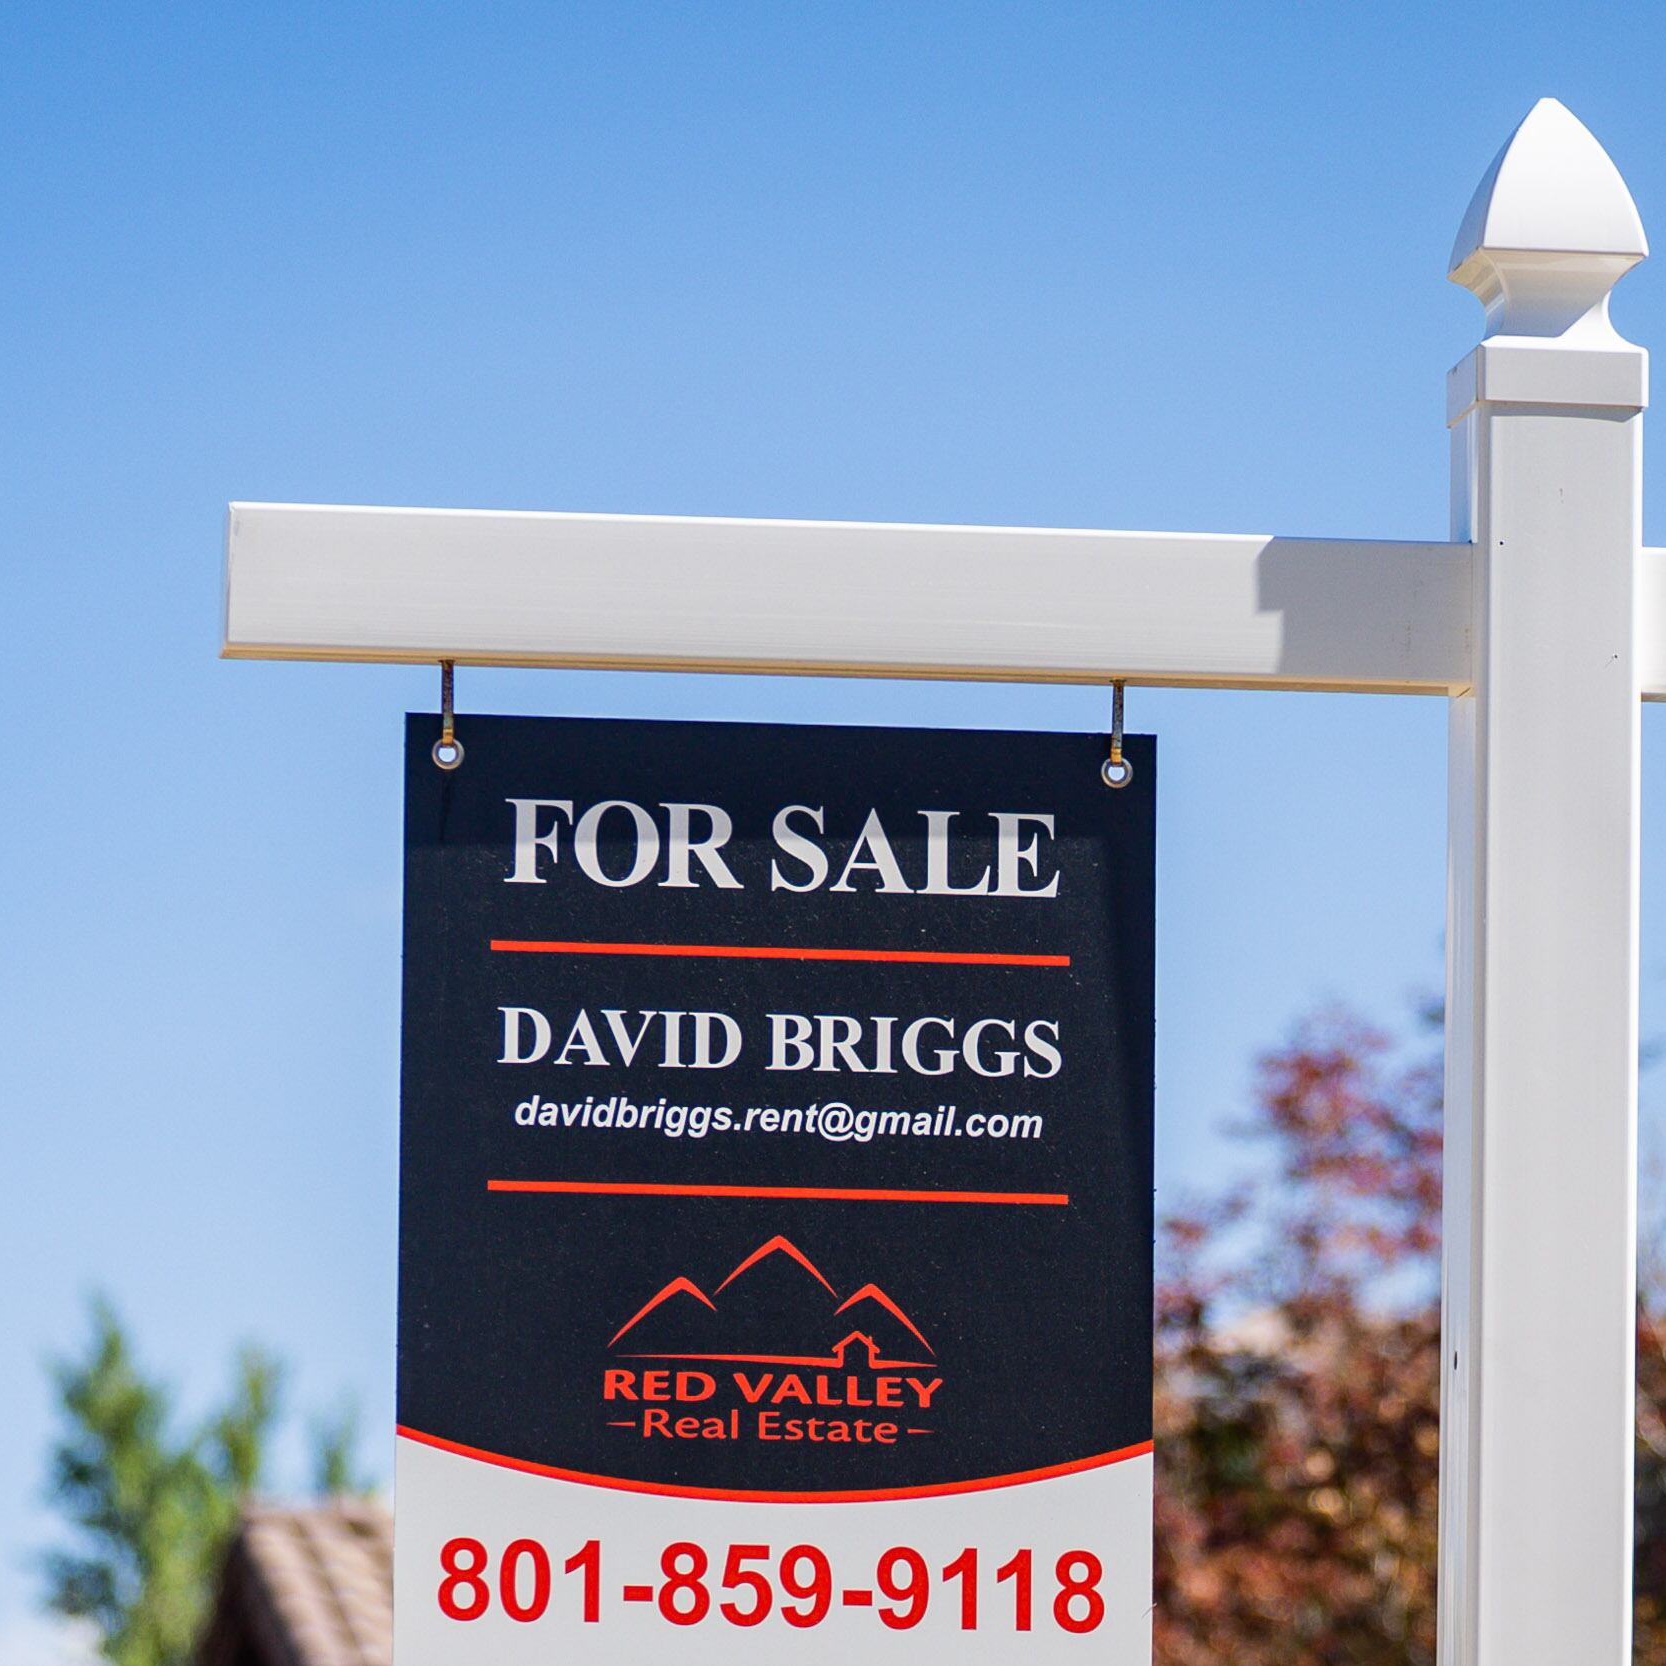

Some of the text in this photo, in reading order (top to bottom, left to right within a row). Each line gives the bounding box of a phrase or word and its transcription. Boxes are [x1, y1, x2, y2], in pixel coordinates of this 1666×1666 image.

[504, 799, 1060, 897] FOR SALE
[497, 1007, 1062, 1079] DAVID BRIGGS
[515, 1095, 1042, 1142] davidbriggs.rent@gmail.com
[604, 1370, 943, 1408] RED VALLEY
[644, 1409, 899, 1443] Real Estate
[438, 1538, 1104, 1633] 801-859-9118
